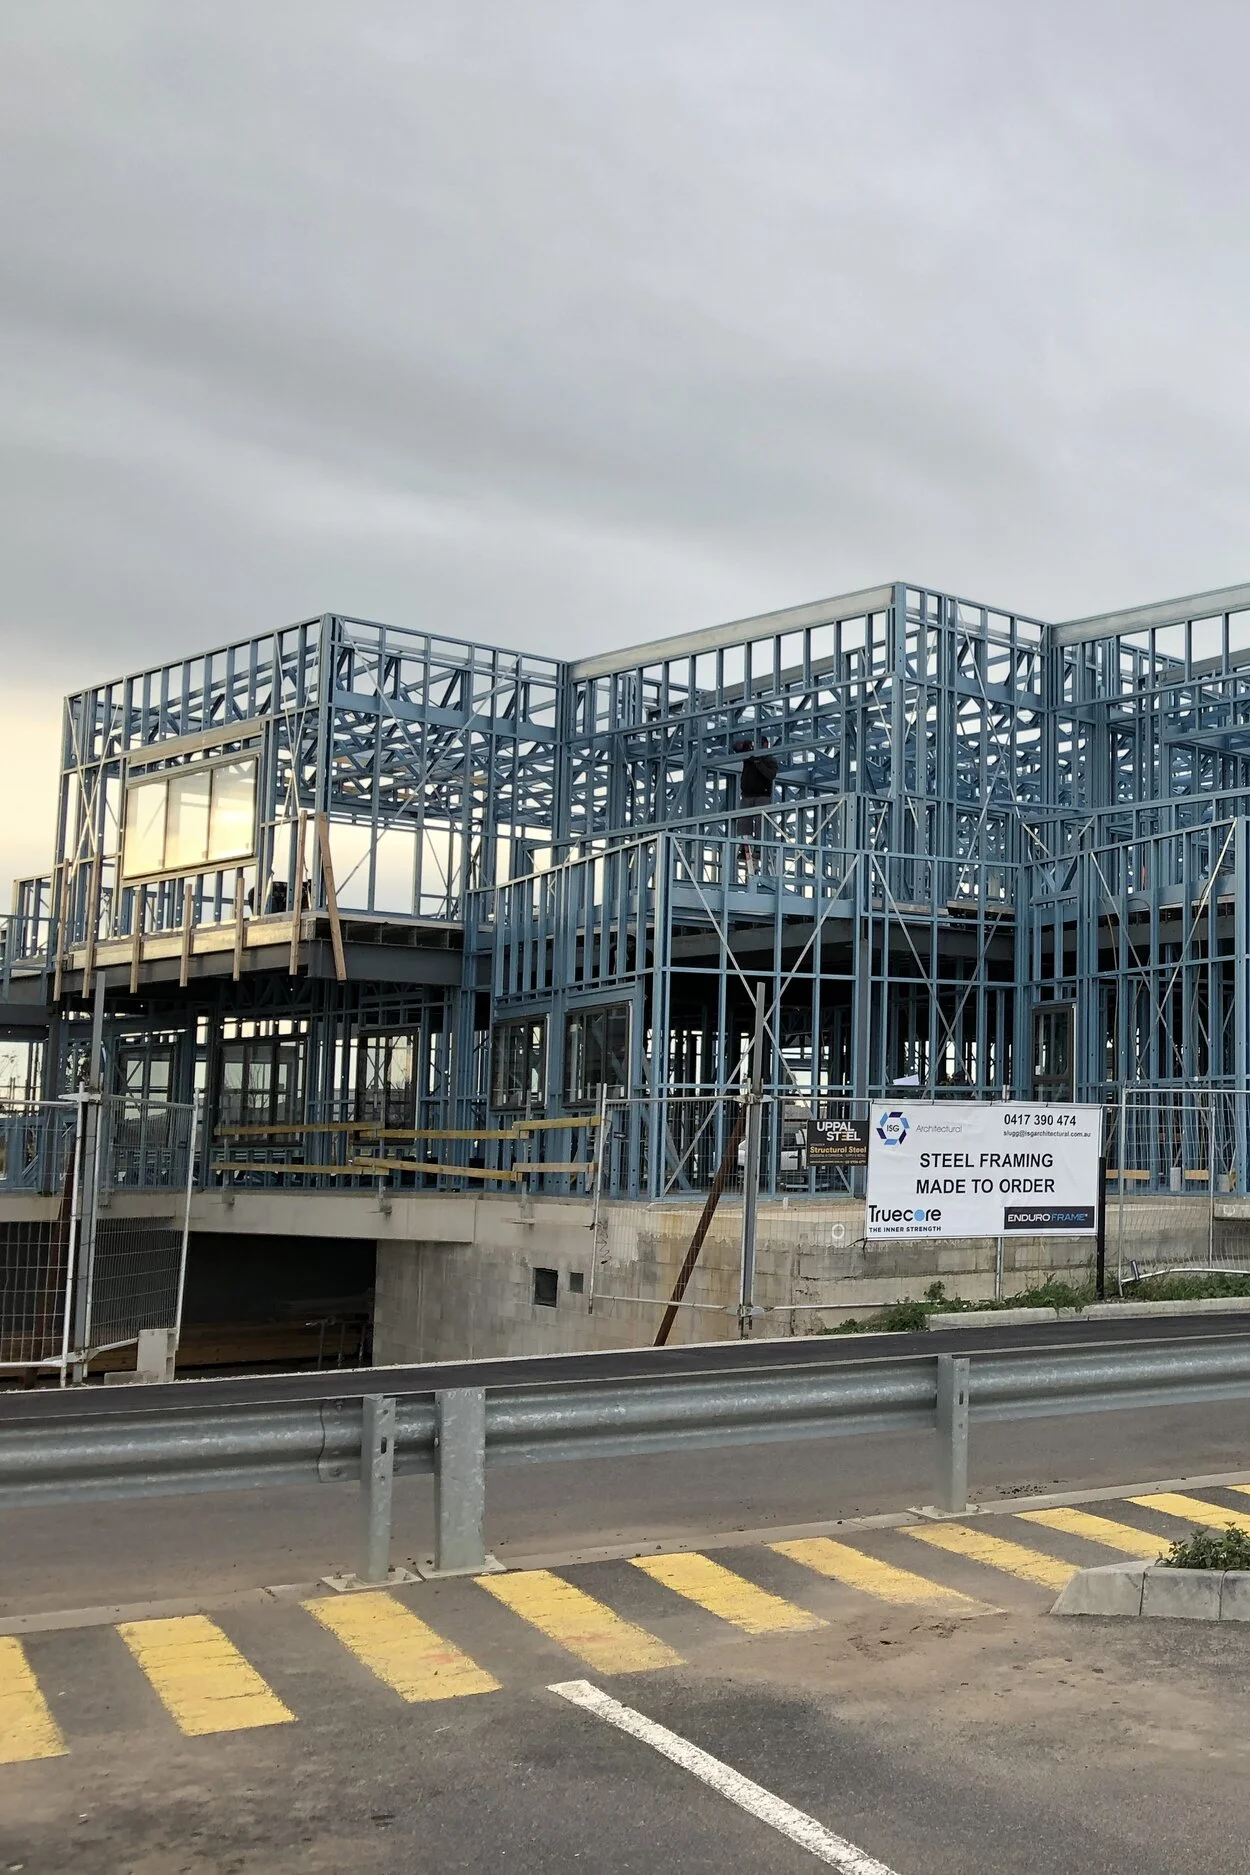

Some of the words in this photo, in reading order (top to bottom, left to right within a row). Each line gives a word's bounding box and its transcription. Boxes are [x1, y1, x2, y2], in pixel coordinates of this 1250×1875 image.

[1004, 1113, 1031, 1125] 0417
[1034, 1114, 1054, 1126] 390
[1056, 1115, 1076, 1126] 474
[816, 1121, 855, 1132] UPPAL
[886, 1124, 900, 1132] ISG
[916, 1124, 962, 1133] Architectural
[826, 1131, 861, 1141] STEEL
[919, 1153, 974, 1168] STEEL
[980, 1152, 1054, 1168] FRAMING
[916, 1179, 966, 1195] MADE
[971, 1179, 994, 1194] TO
[999, 1178, 1055, 1194] ORDER
[868, 1204, 942, 1222] Truecore
